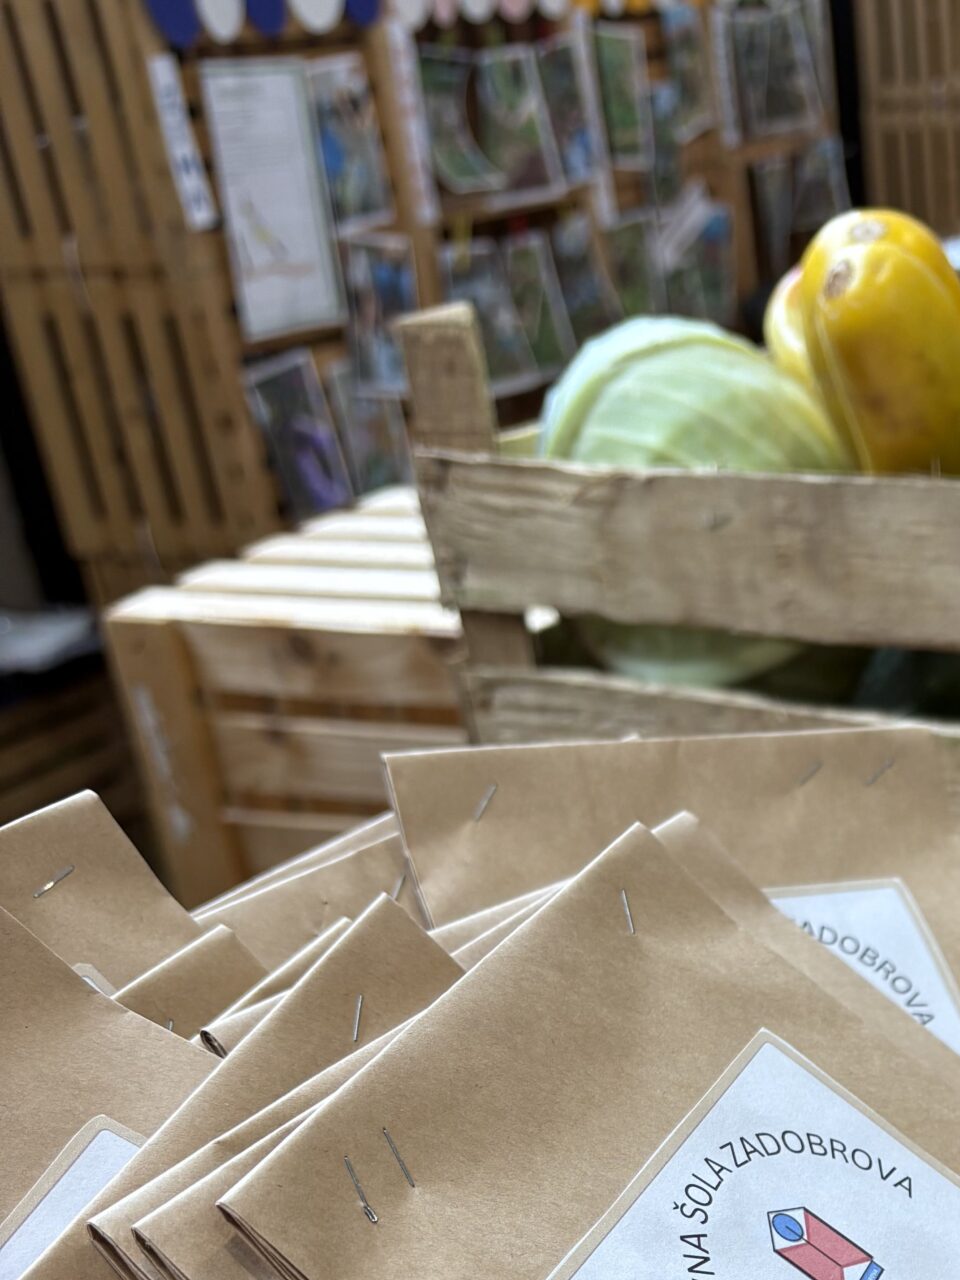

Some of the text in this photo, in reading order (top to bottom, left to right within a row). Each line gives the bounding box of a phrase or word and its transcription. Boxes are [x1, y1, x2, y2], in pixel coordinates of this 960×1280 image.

[800, 920, 935, 1026] ADOBROVA
[672, 1157, 733, 1224] ŠOLA
[719, 1130, 912, 1198] ZADOBROVA
